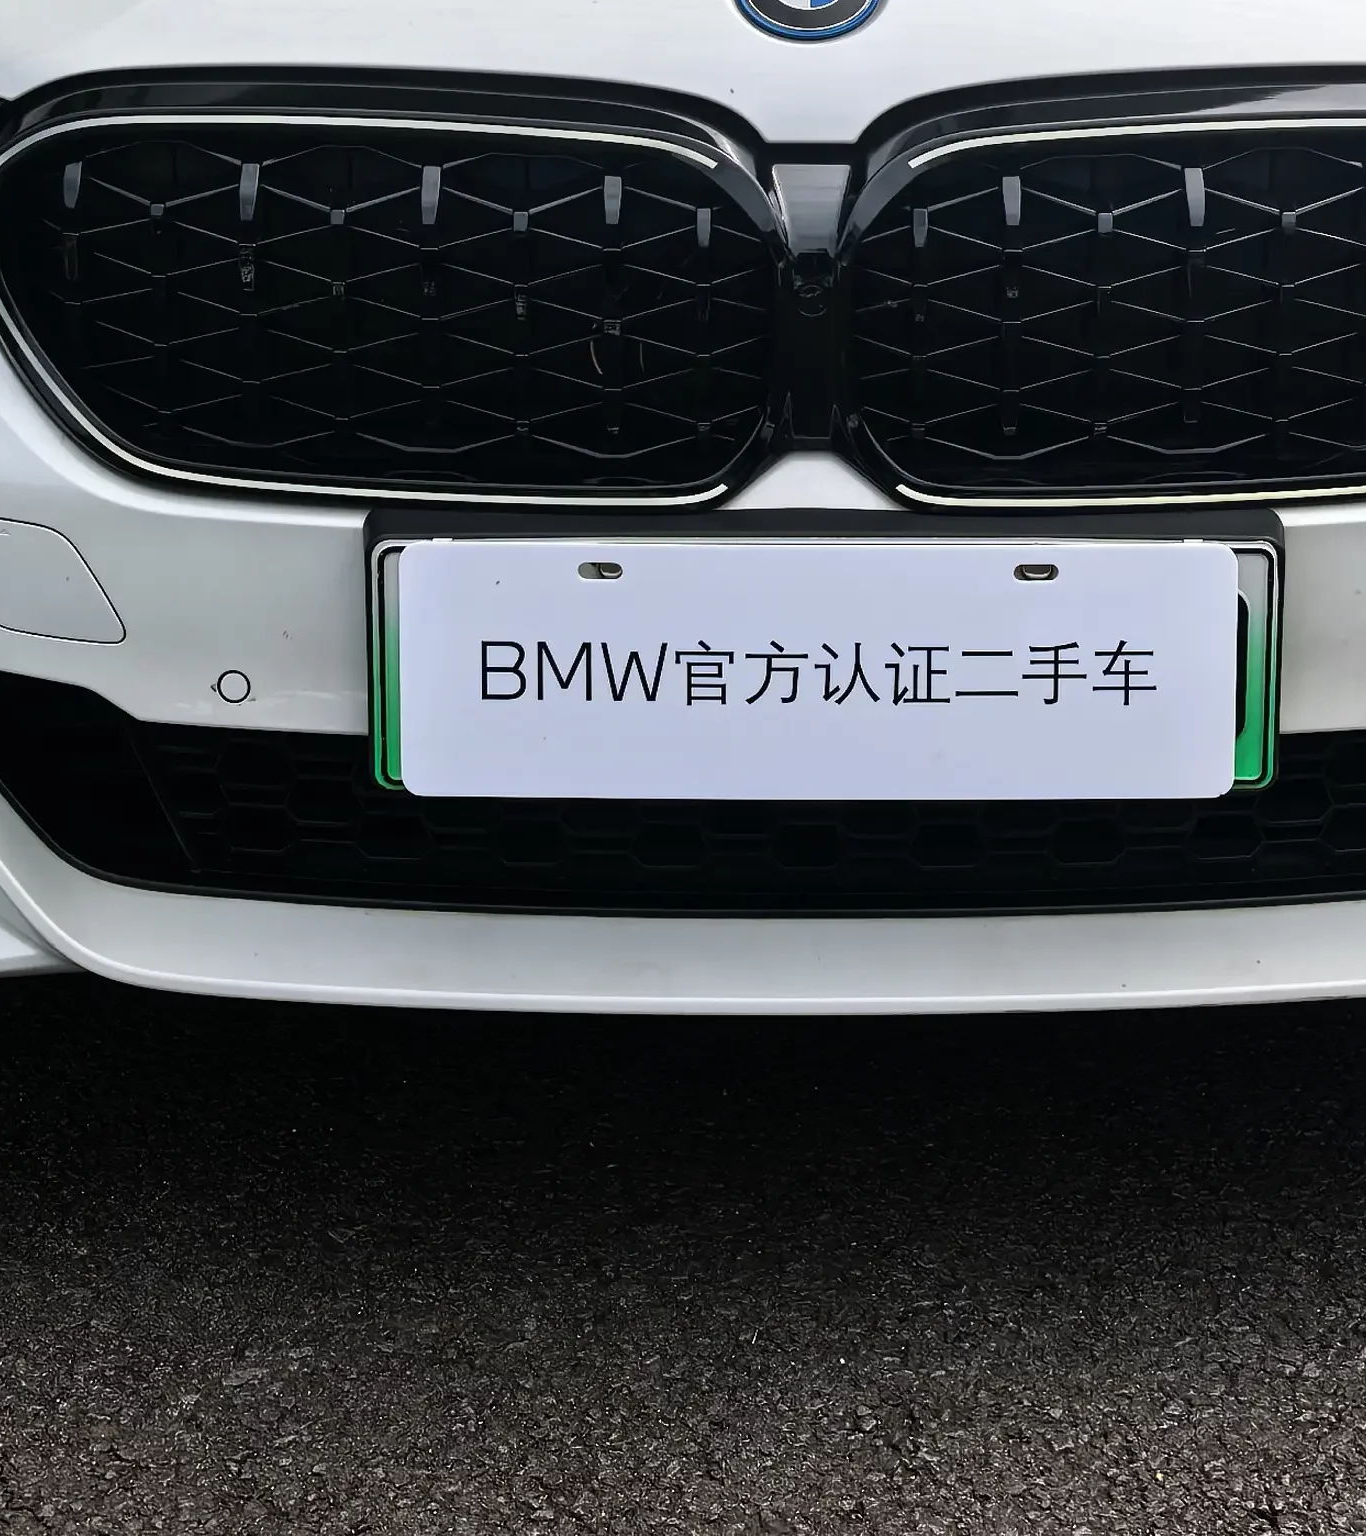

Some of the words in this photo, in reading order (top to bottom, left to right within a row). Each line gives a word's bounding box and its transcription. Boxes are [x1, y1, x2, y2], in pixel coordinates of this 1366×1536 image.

[479, 638, 1158, 707] BMW官方认证二手车
